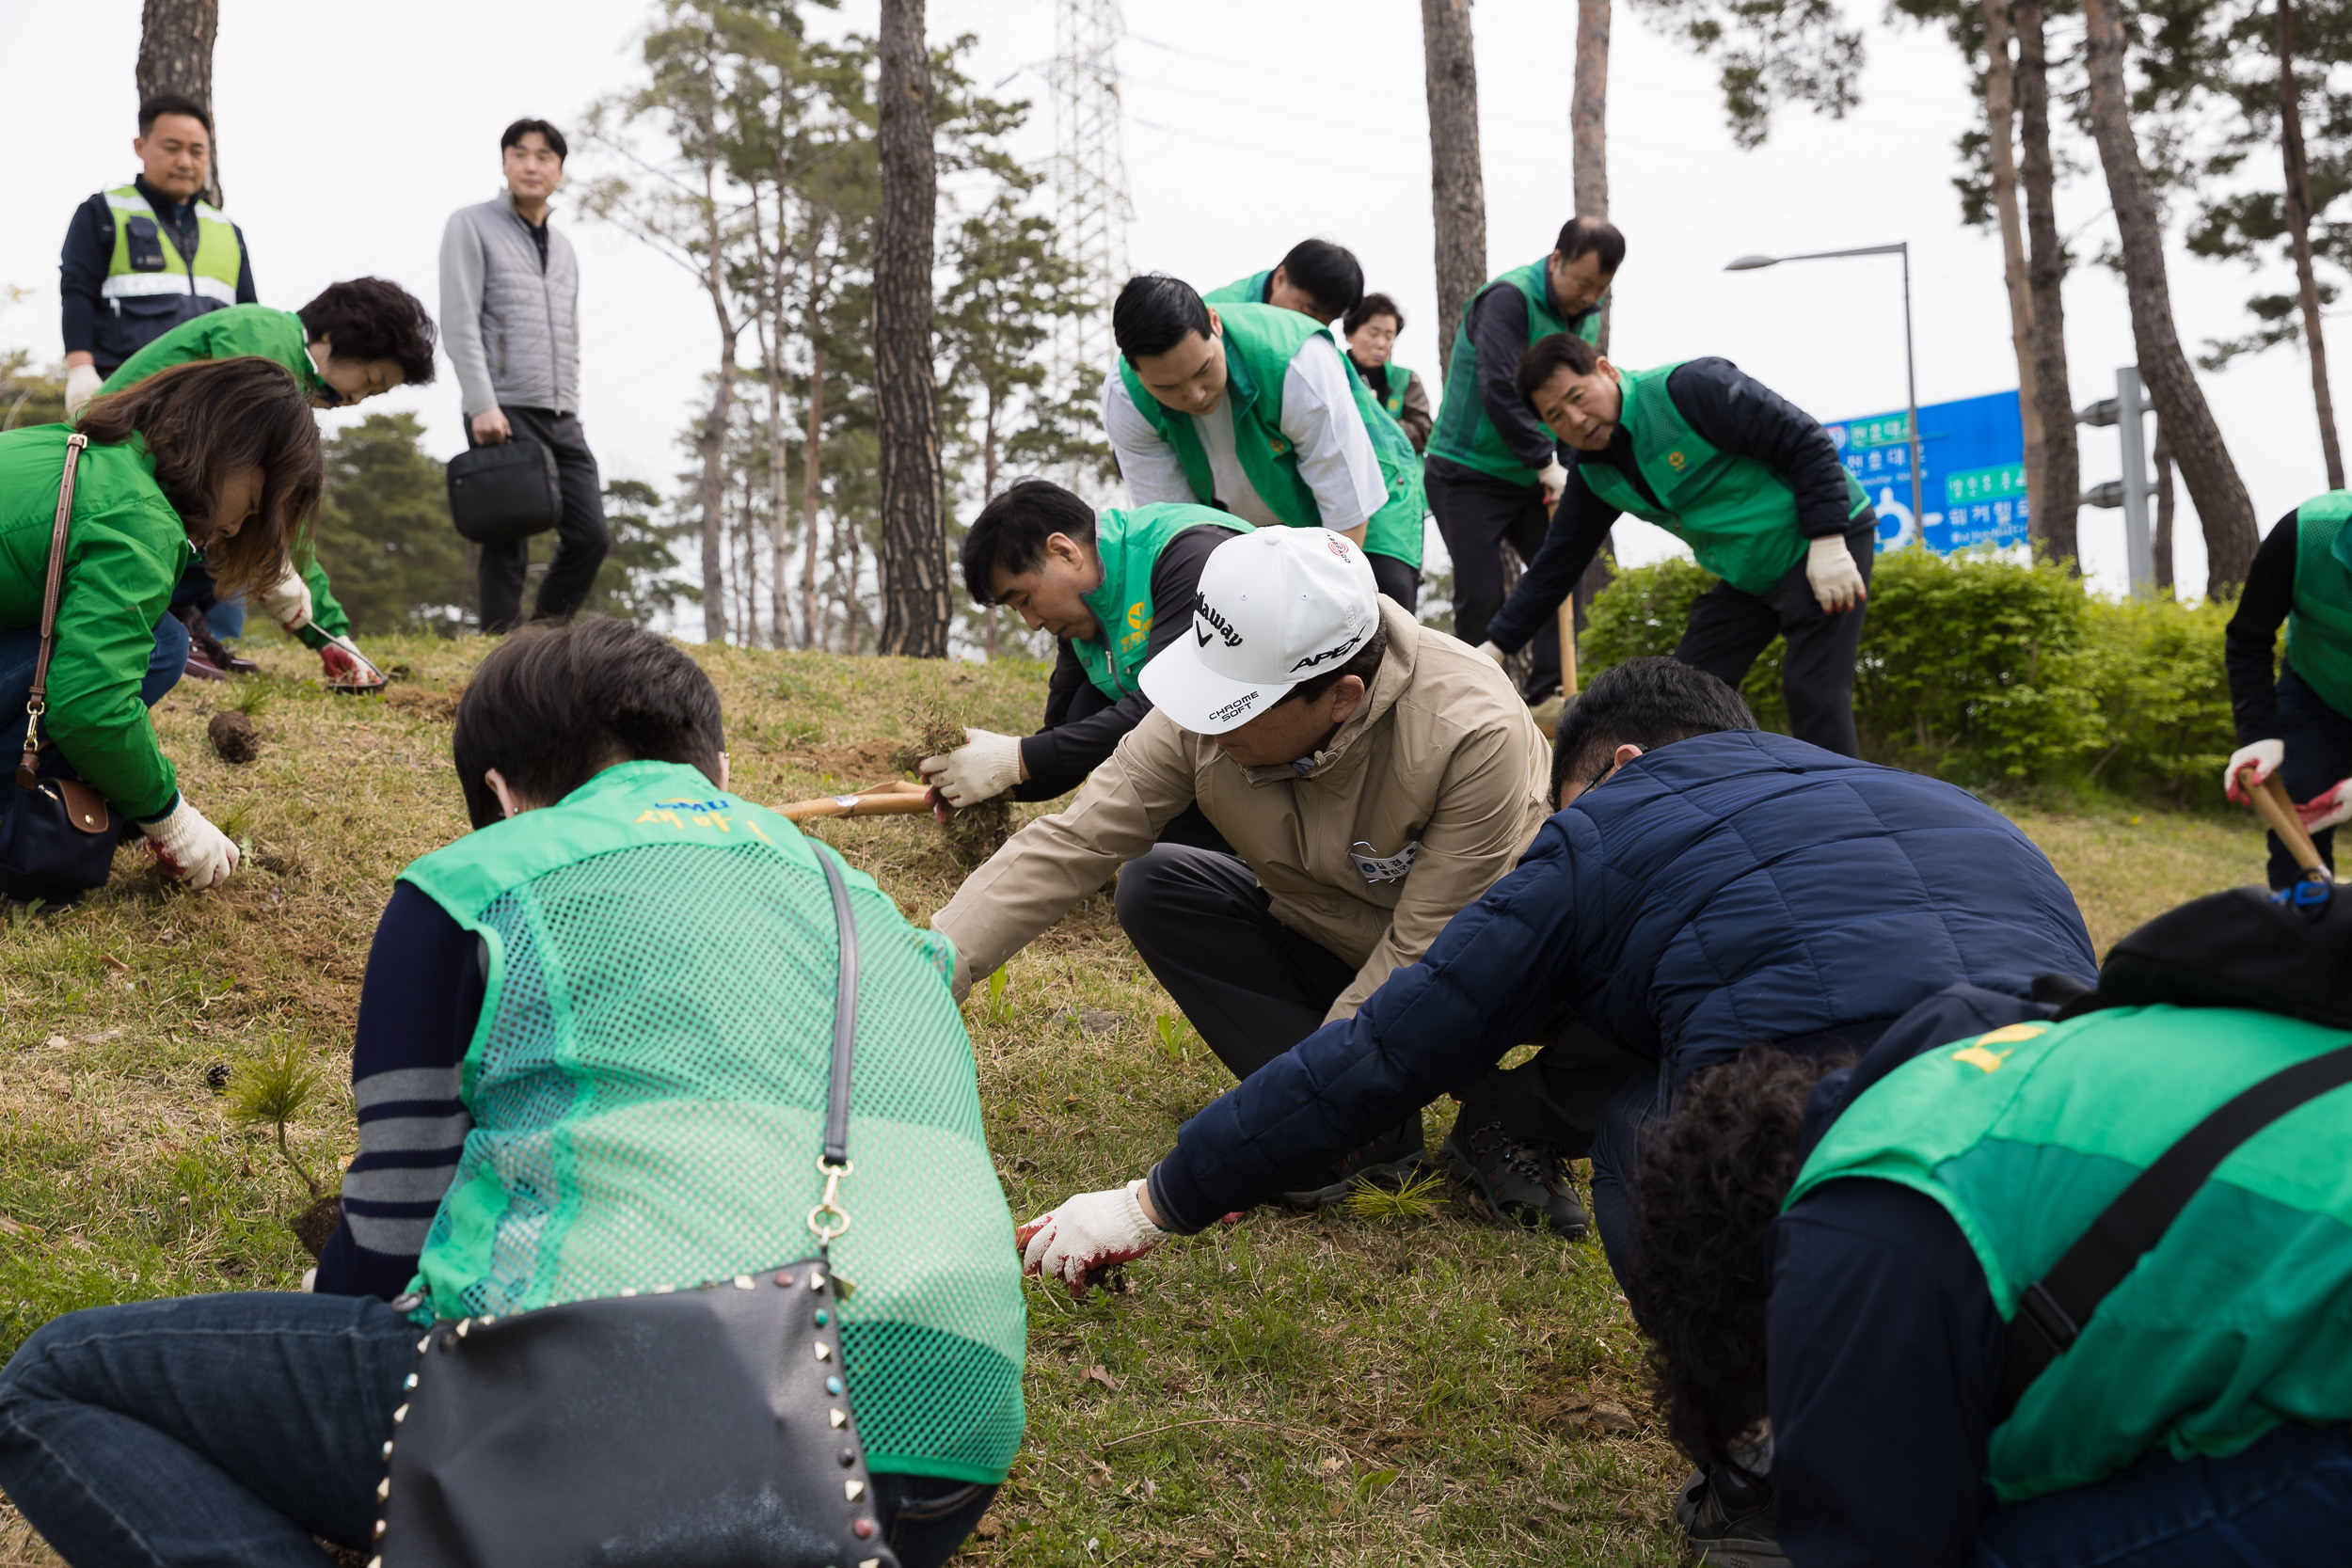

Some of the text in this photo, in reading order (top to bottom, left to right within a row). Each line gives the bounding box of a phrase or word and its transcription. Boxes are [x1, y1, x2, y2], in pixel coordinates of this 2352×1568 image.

[1290, 626, 1366, 673] APEX
[1209, 691, 1260, 721] CHROME
[1222, 703, 1251, 722] SOFT
